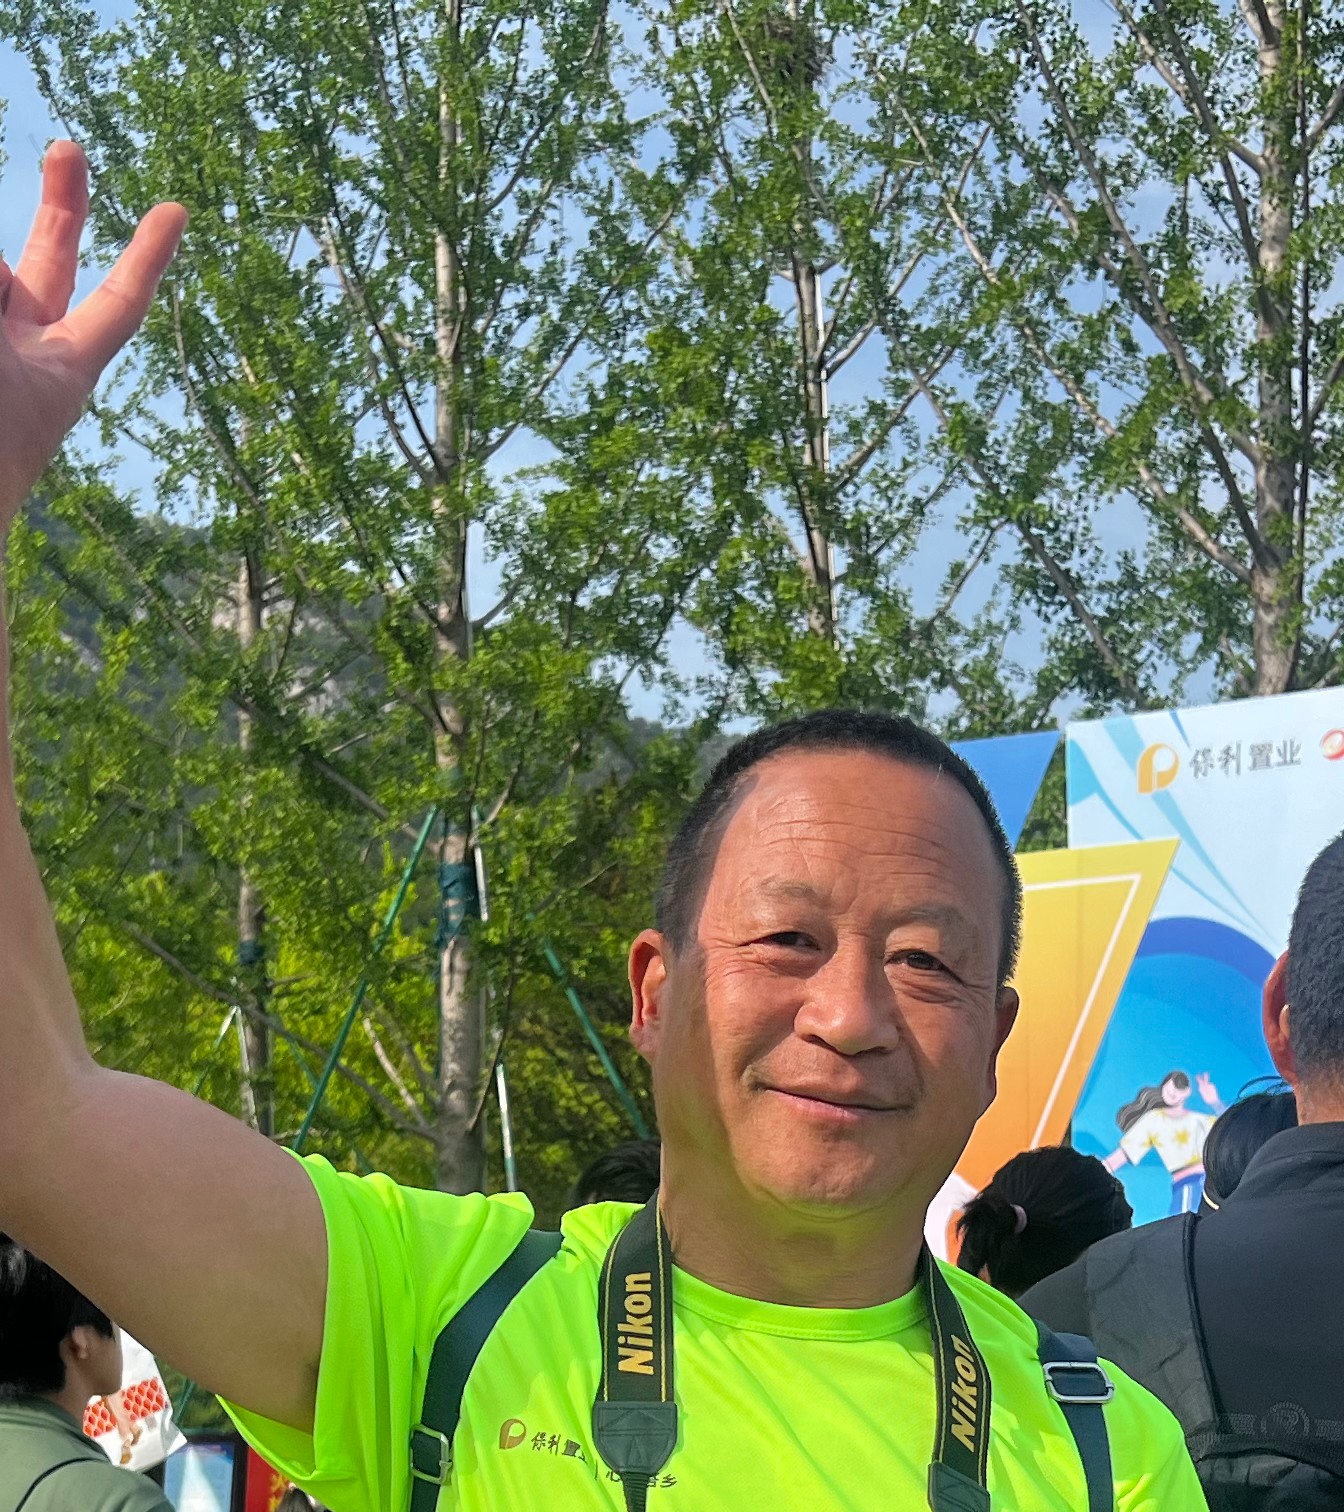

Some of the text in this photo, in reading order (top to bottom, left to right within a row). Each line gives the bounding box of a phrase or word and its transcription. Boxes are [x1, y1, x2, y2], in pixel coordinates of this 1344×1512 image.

[1189, 738, 1303, 780] 保利置业
[617, 1271, 654, 1376] Nikon
[950, 1334, 977, 1453] Nikon
